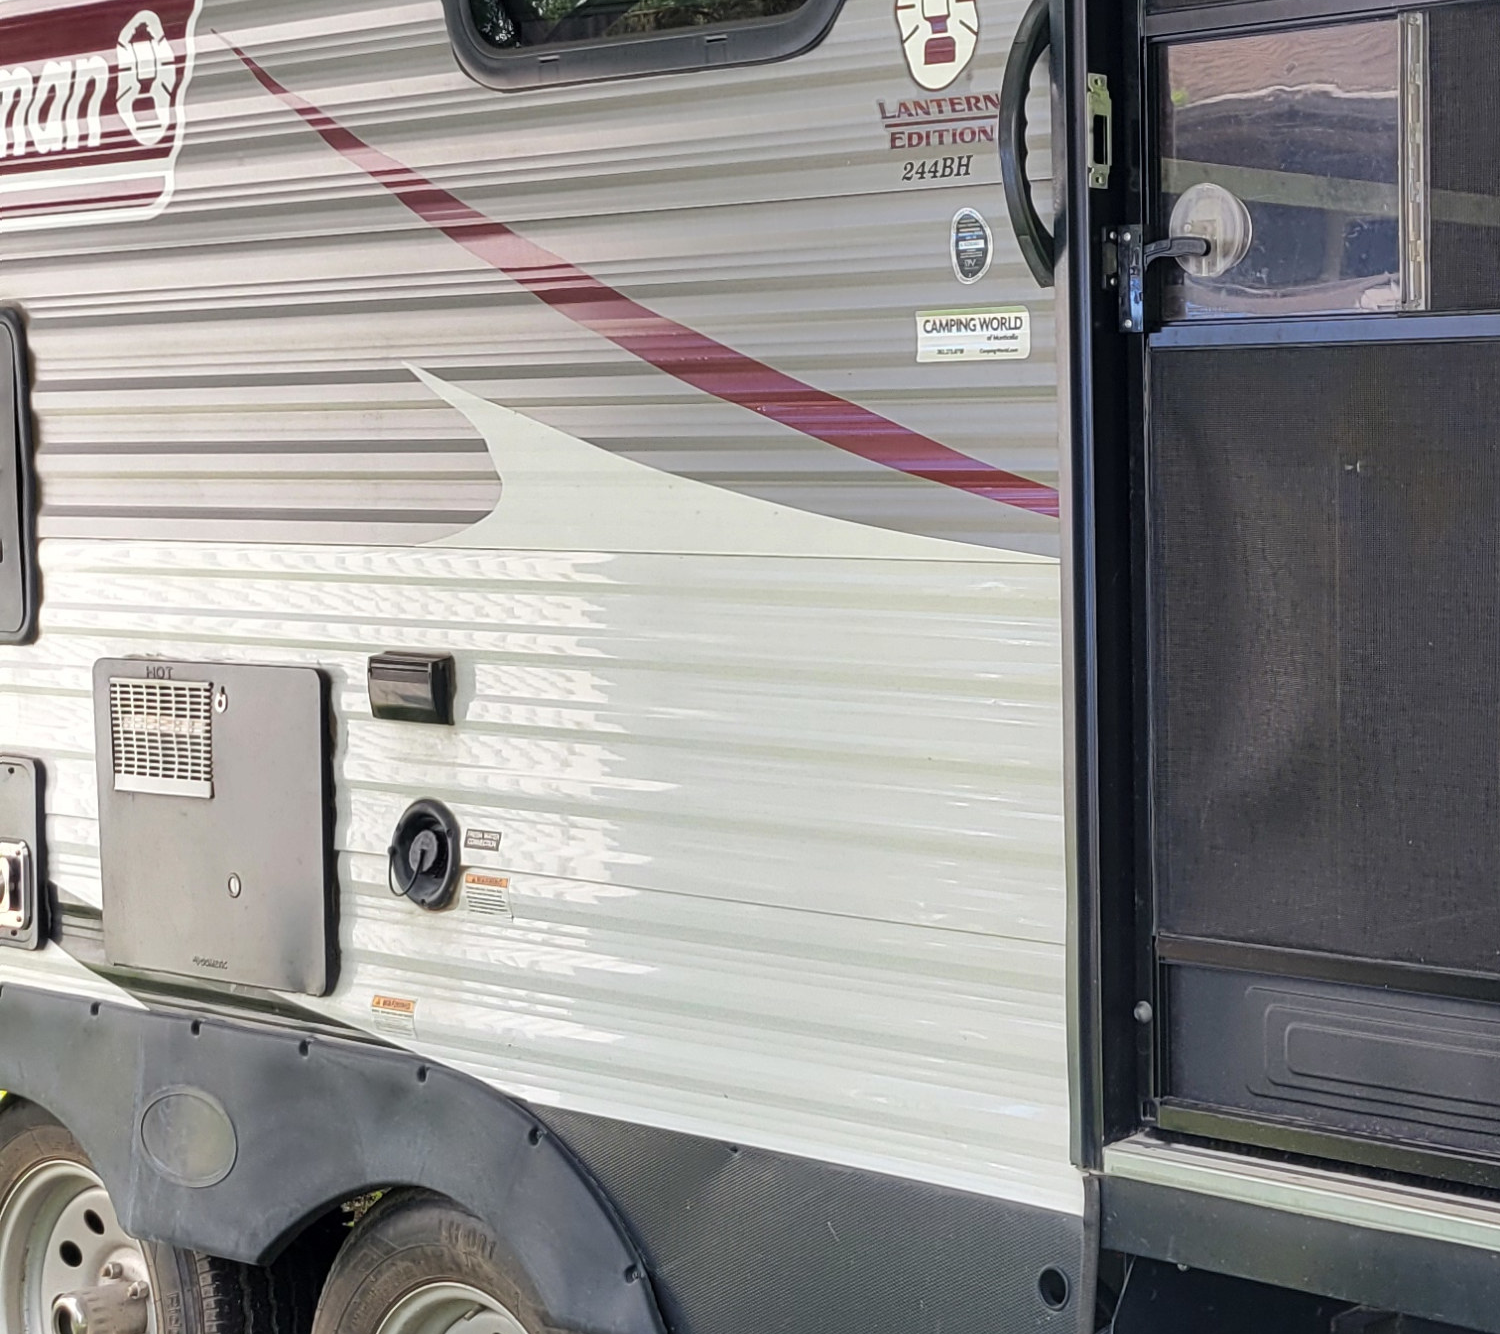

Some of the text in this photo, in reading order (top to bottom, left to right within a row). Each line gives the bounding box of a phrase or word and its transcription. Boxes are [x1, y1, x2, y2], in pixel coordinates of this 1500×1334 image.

[877, 92, 1001, 120] LANTERN
[890, 124, 995, 150] EDITION
[901, 154, 974, 182] 244BH
[923, 315, 1023, 334] CAMPING WORLD
[146, 665, 174, 679] HOT
